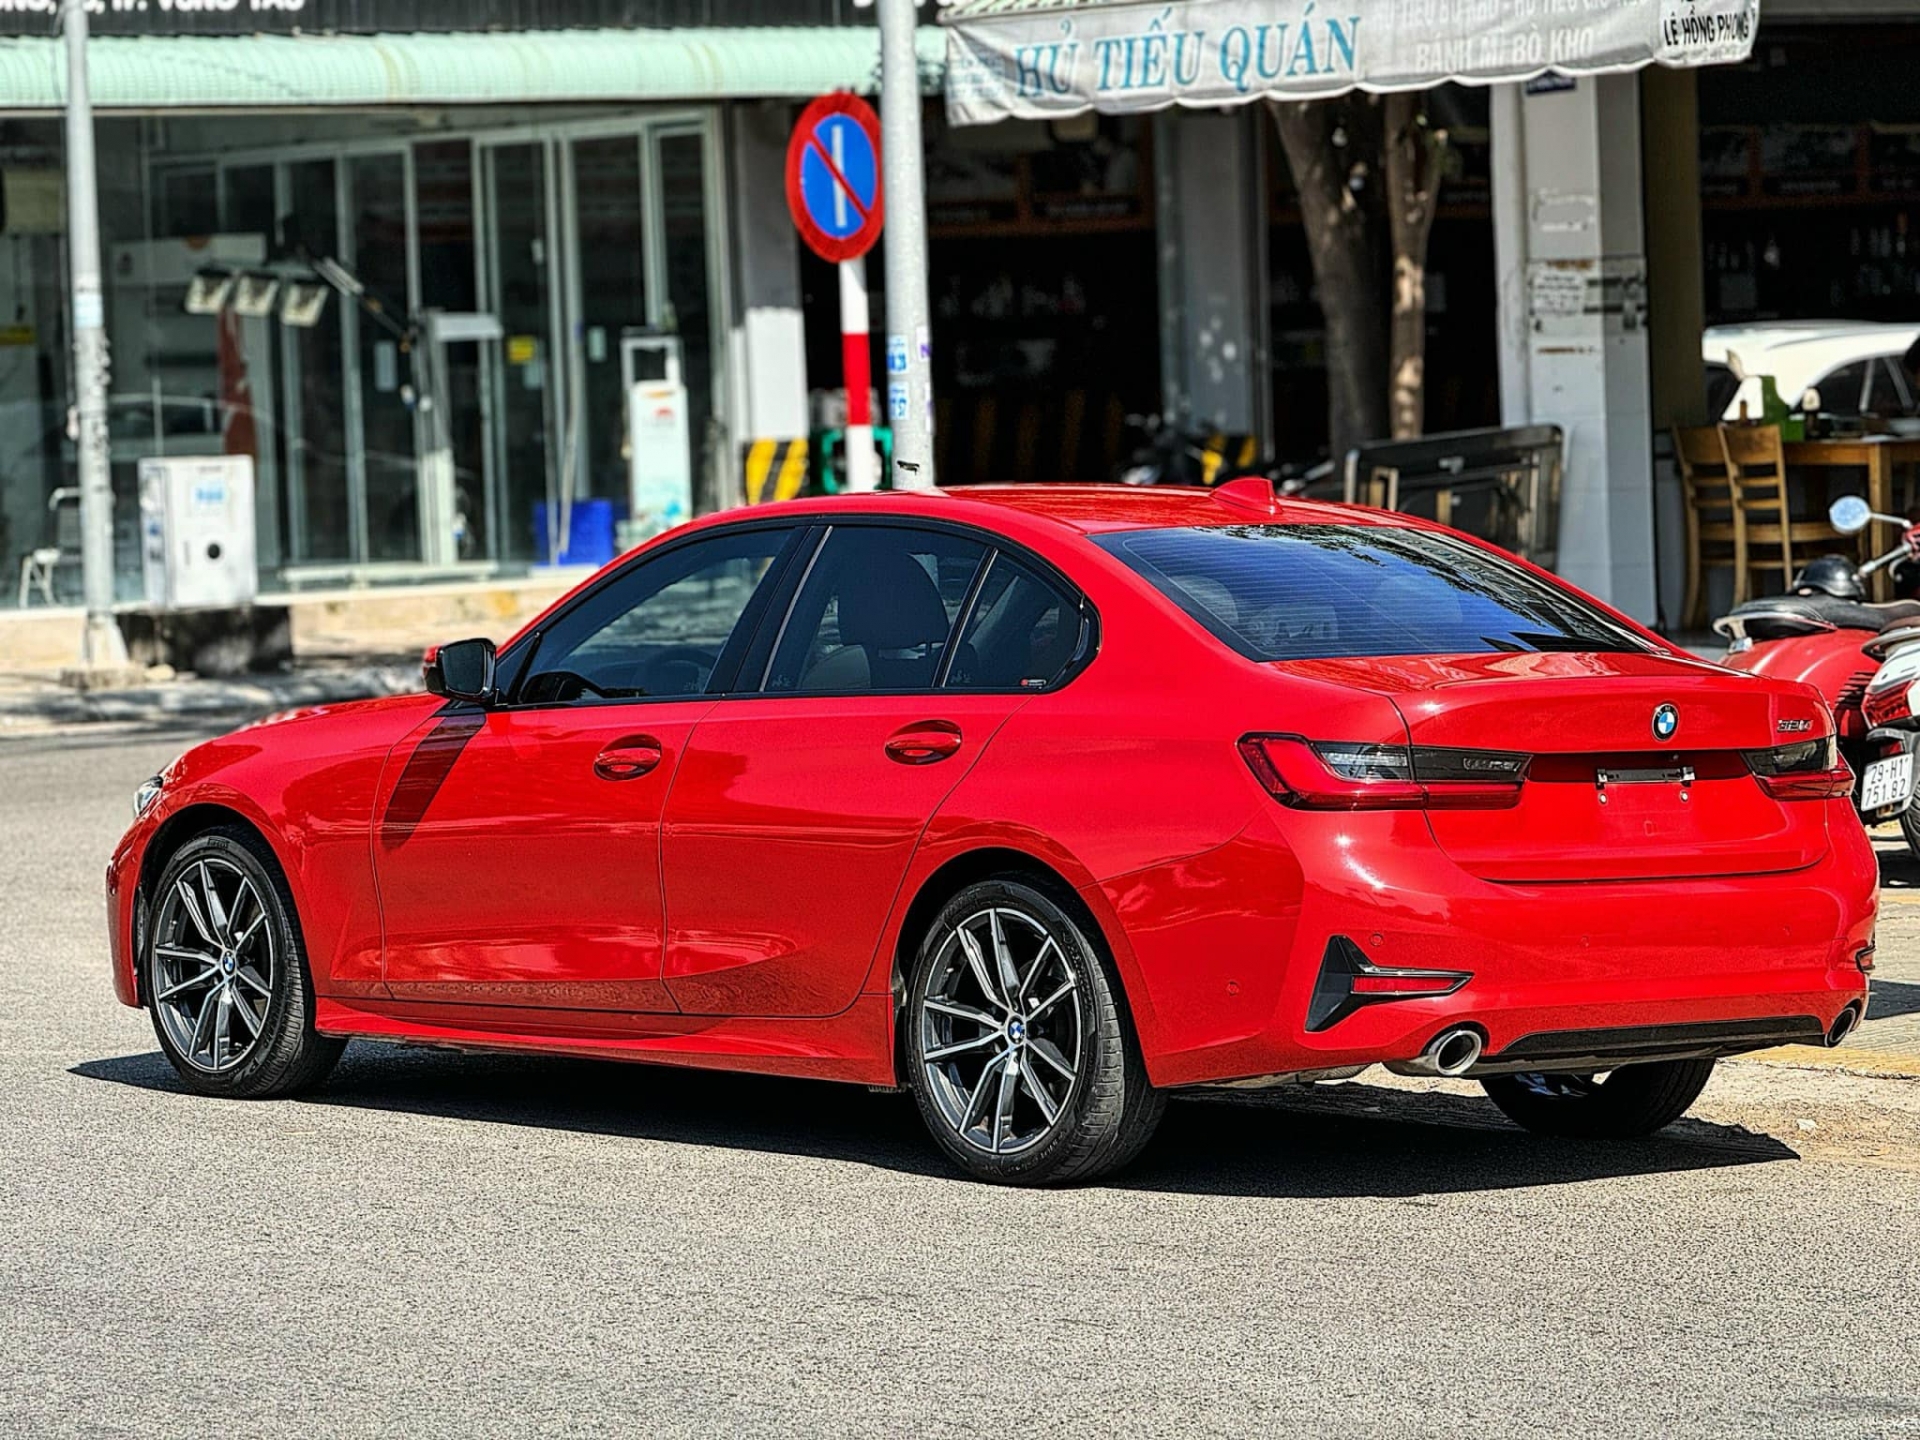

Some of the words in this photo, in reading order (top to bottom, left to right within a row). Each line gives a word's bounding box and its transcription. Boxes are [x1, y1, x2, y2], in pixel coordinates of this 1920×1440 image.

[1015, 18, 1080, 97] HỦ
[1094, 6, 1206, 91] TIẾU
[1220, 2, 1361, 93] QUÁN
[1549, 26, 1594, 62] KHO
